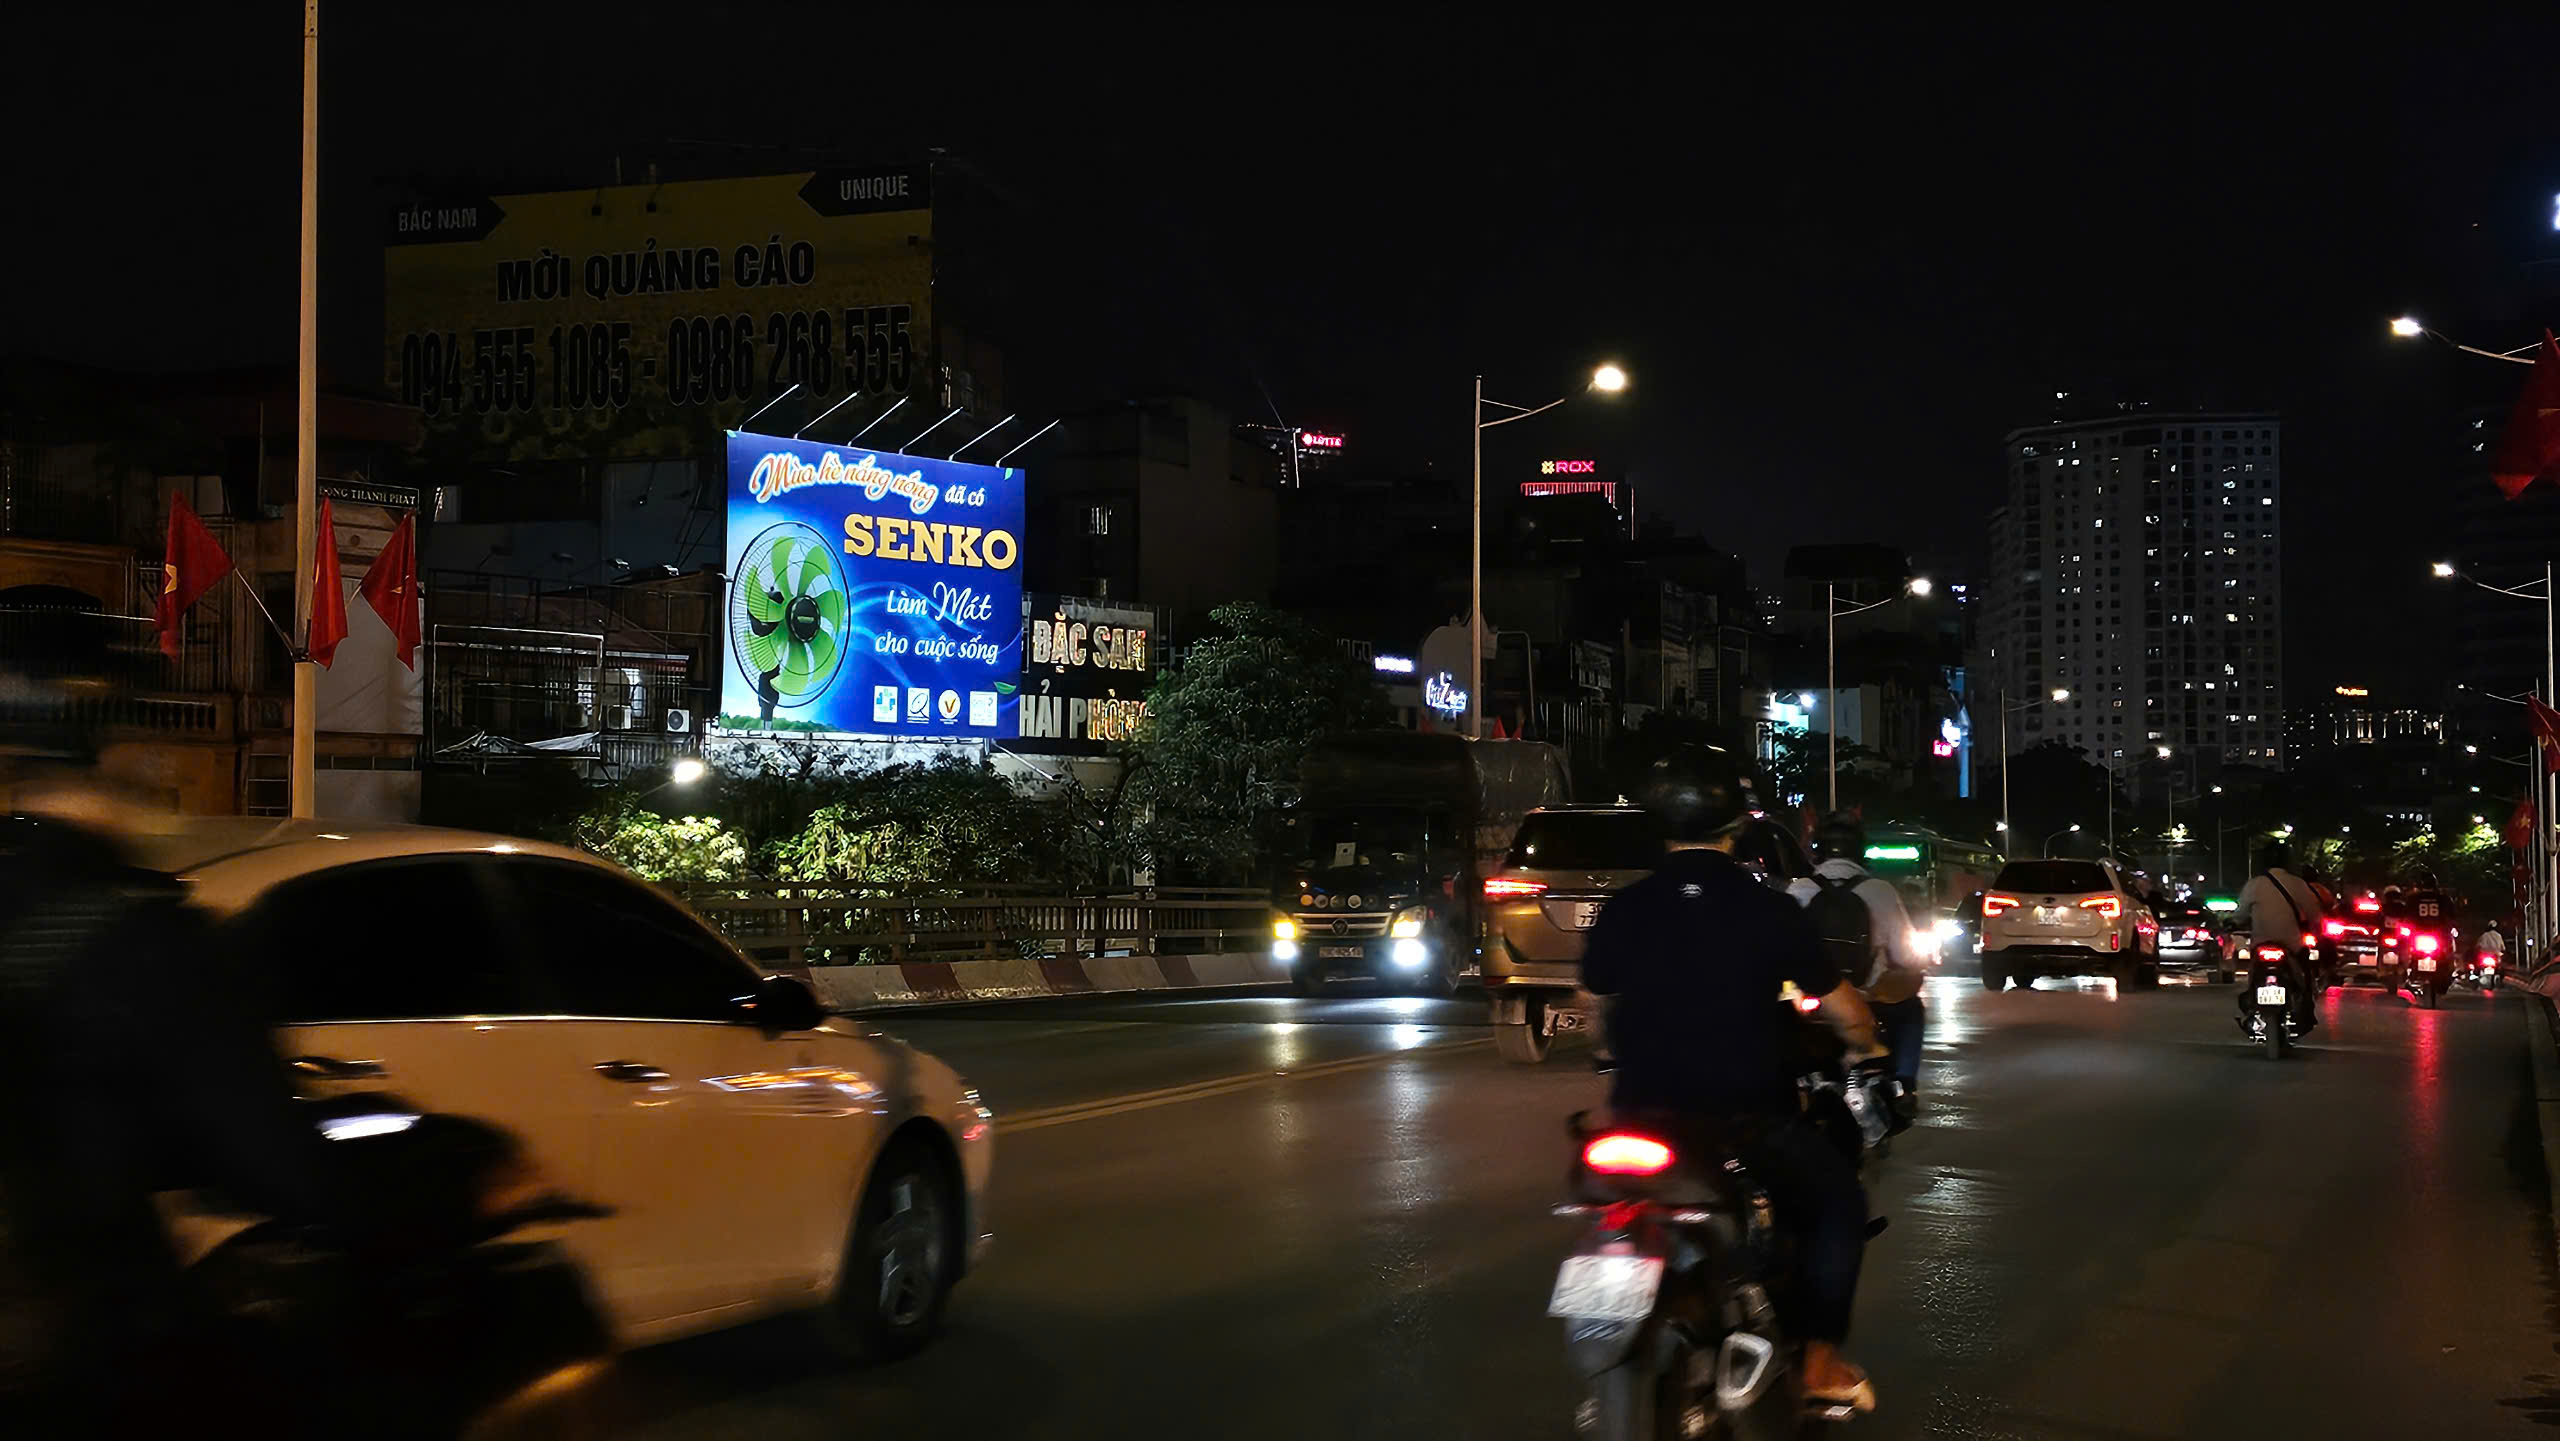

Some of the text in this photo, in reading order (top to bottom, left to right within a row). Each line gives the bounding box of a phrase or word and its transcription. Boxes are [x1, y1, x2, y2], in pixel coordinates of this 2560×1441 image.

[840, 175, 909, 201] UNIQUE
[437, 207, 477, 229] NAM
[496, 232, 816, 304] MỜI QUẢNG CÁO
[401, 330, 462, 418] 094
[472, 326, 536, 414] 555
[549, 320, 633, 412] 1085
[668, 311, 754, 407] 0986
[767, 308, 832, 400] 268
[843, 303, 912, 395] 555
[751, 453, 814, 501] Mùa
[818, 451, 842, 482] hè
[845, 454, 891, 498] nắng
[891, 471, 938, 512] nóng
[968, 487, 985, 507] có
[1556, 460, 1595, 473] ROX
[843, 513, 1018, 570] SENKO
[887, 581, 992, 625] Làm Mát
[875, 631, 999, 665] cho cuộc sống
[1032, 611, 1087, 674] ĐẶC
[1019, 679, 1062, 739] HẢI
[2419, 903, 2439, 917] 86
